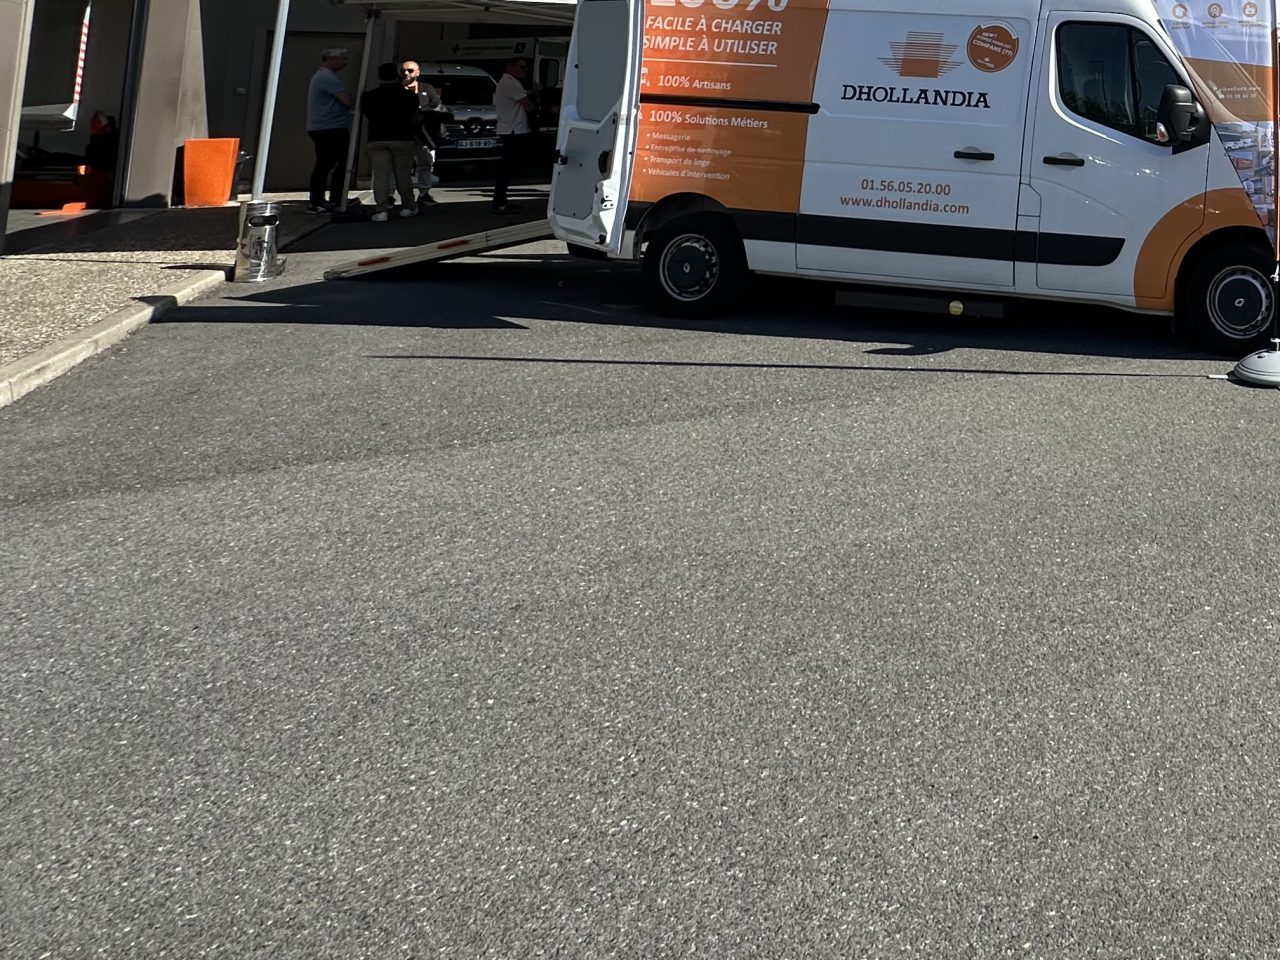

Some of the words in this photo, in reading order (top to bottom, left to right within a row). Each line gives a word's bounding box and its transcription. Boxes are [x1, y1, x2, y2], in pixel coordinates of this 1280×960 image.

[645, 15, 694, 31] FACILE
[696, 14, 707, 32] À
[711, 18, 782, 35] CHARGER
[643, 35, 695, 51] SIMPLE
[698, 34, 709, 52] À
[713, 39, 778, 55] UTILISER
[657, 74, 690, 88] 100%
[692, 79, 731, 90] Artisans
[841, 84, 991, 108] DHOLLANDIA
[649, 109, 682, 123] 100%
[684, 114, 729, 127] Solutions
[730, 116, 768, 129] Métiers
[652, 132, 691, 142] Messagerie
[650, 143, 686, 154] Entreprise
[649, 155, 682, 166] Transport
[683, 157, 692, 165] de
[861, 178, 951, 196] 01.56.05.20.00
[840, 195, 970, 215] www.dhollandia.com
